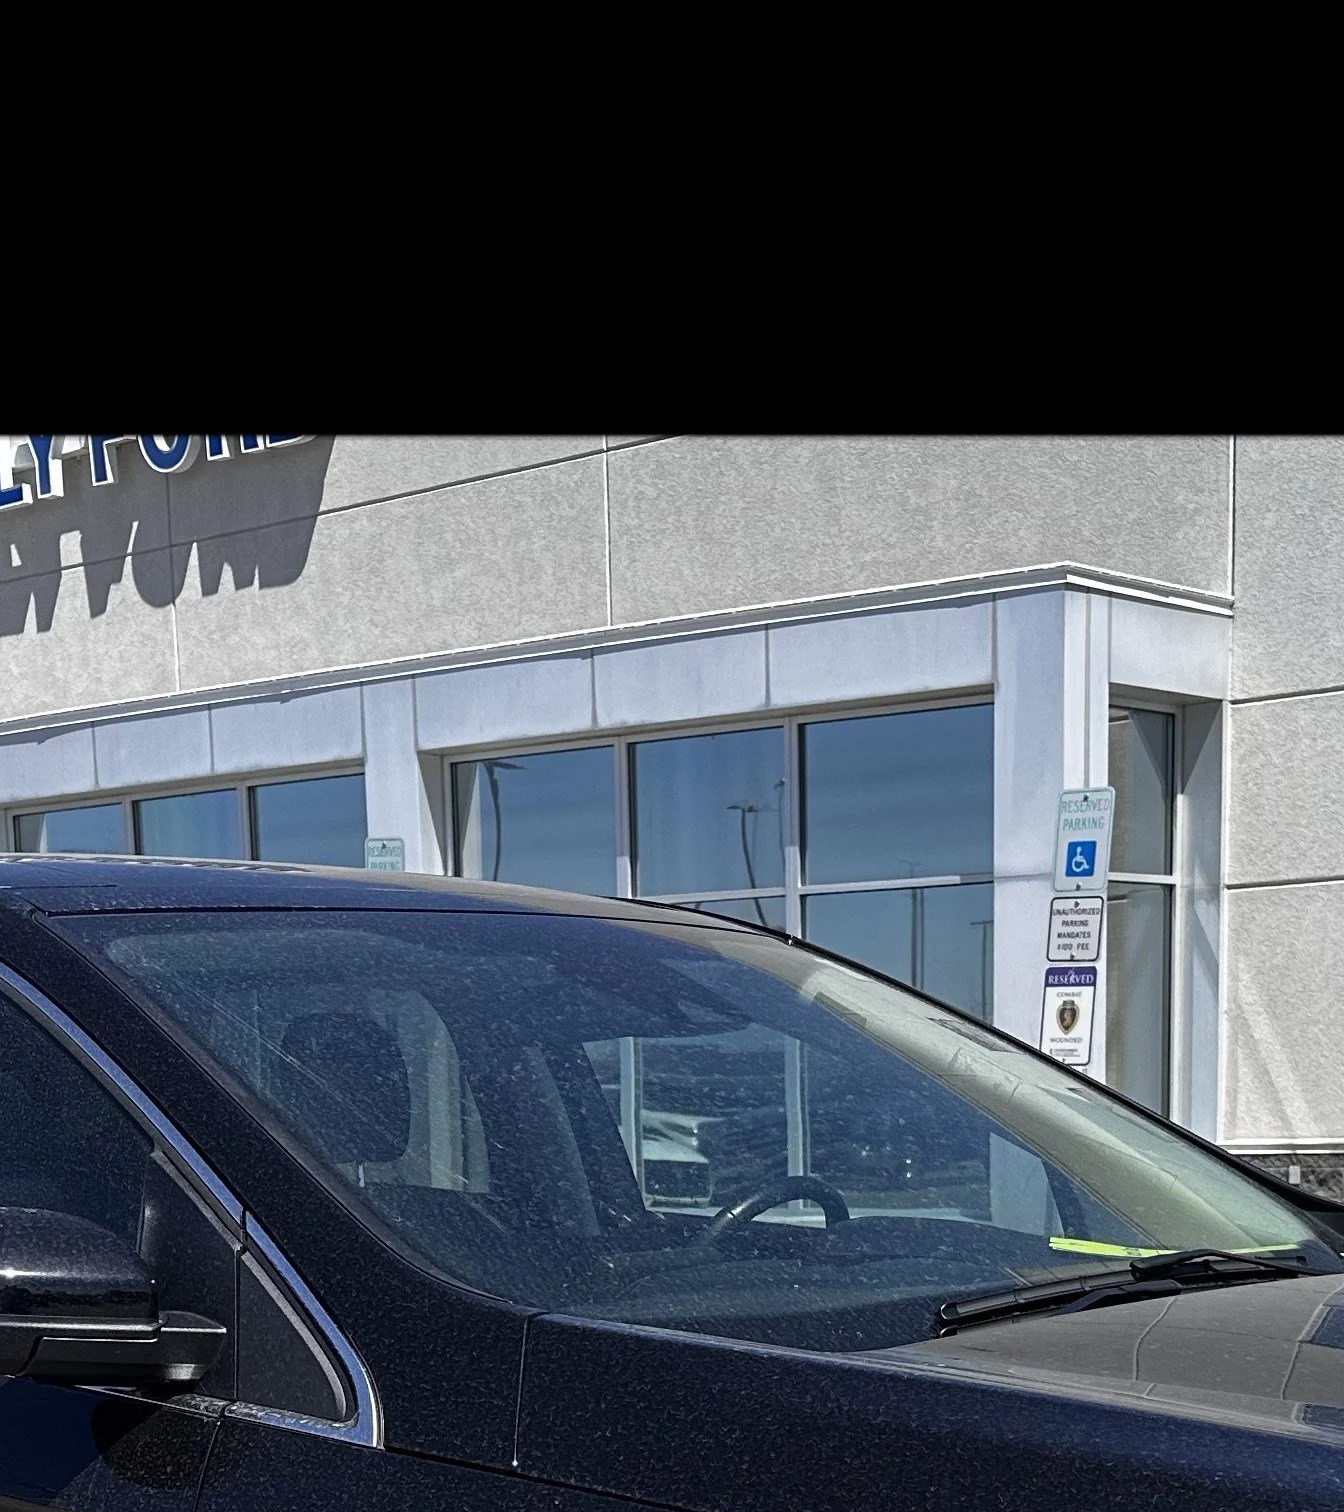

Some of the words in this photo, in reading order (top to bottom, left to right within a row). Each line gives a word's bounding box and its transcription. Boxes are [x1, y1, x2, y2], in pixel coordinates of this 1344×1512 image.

[1060, 799, 1110, 813] RESERVED
[1063, 816, 1104, 831] PARKING
[1048, 974, 1094, 985] RESERVED
